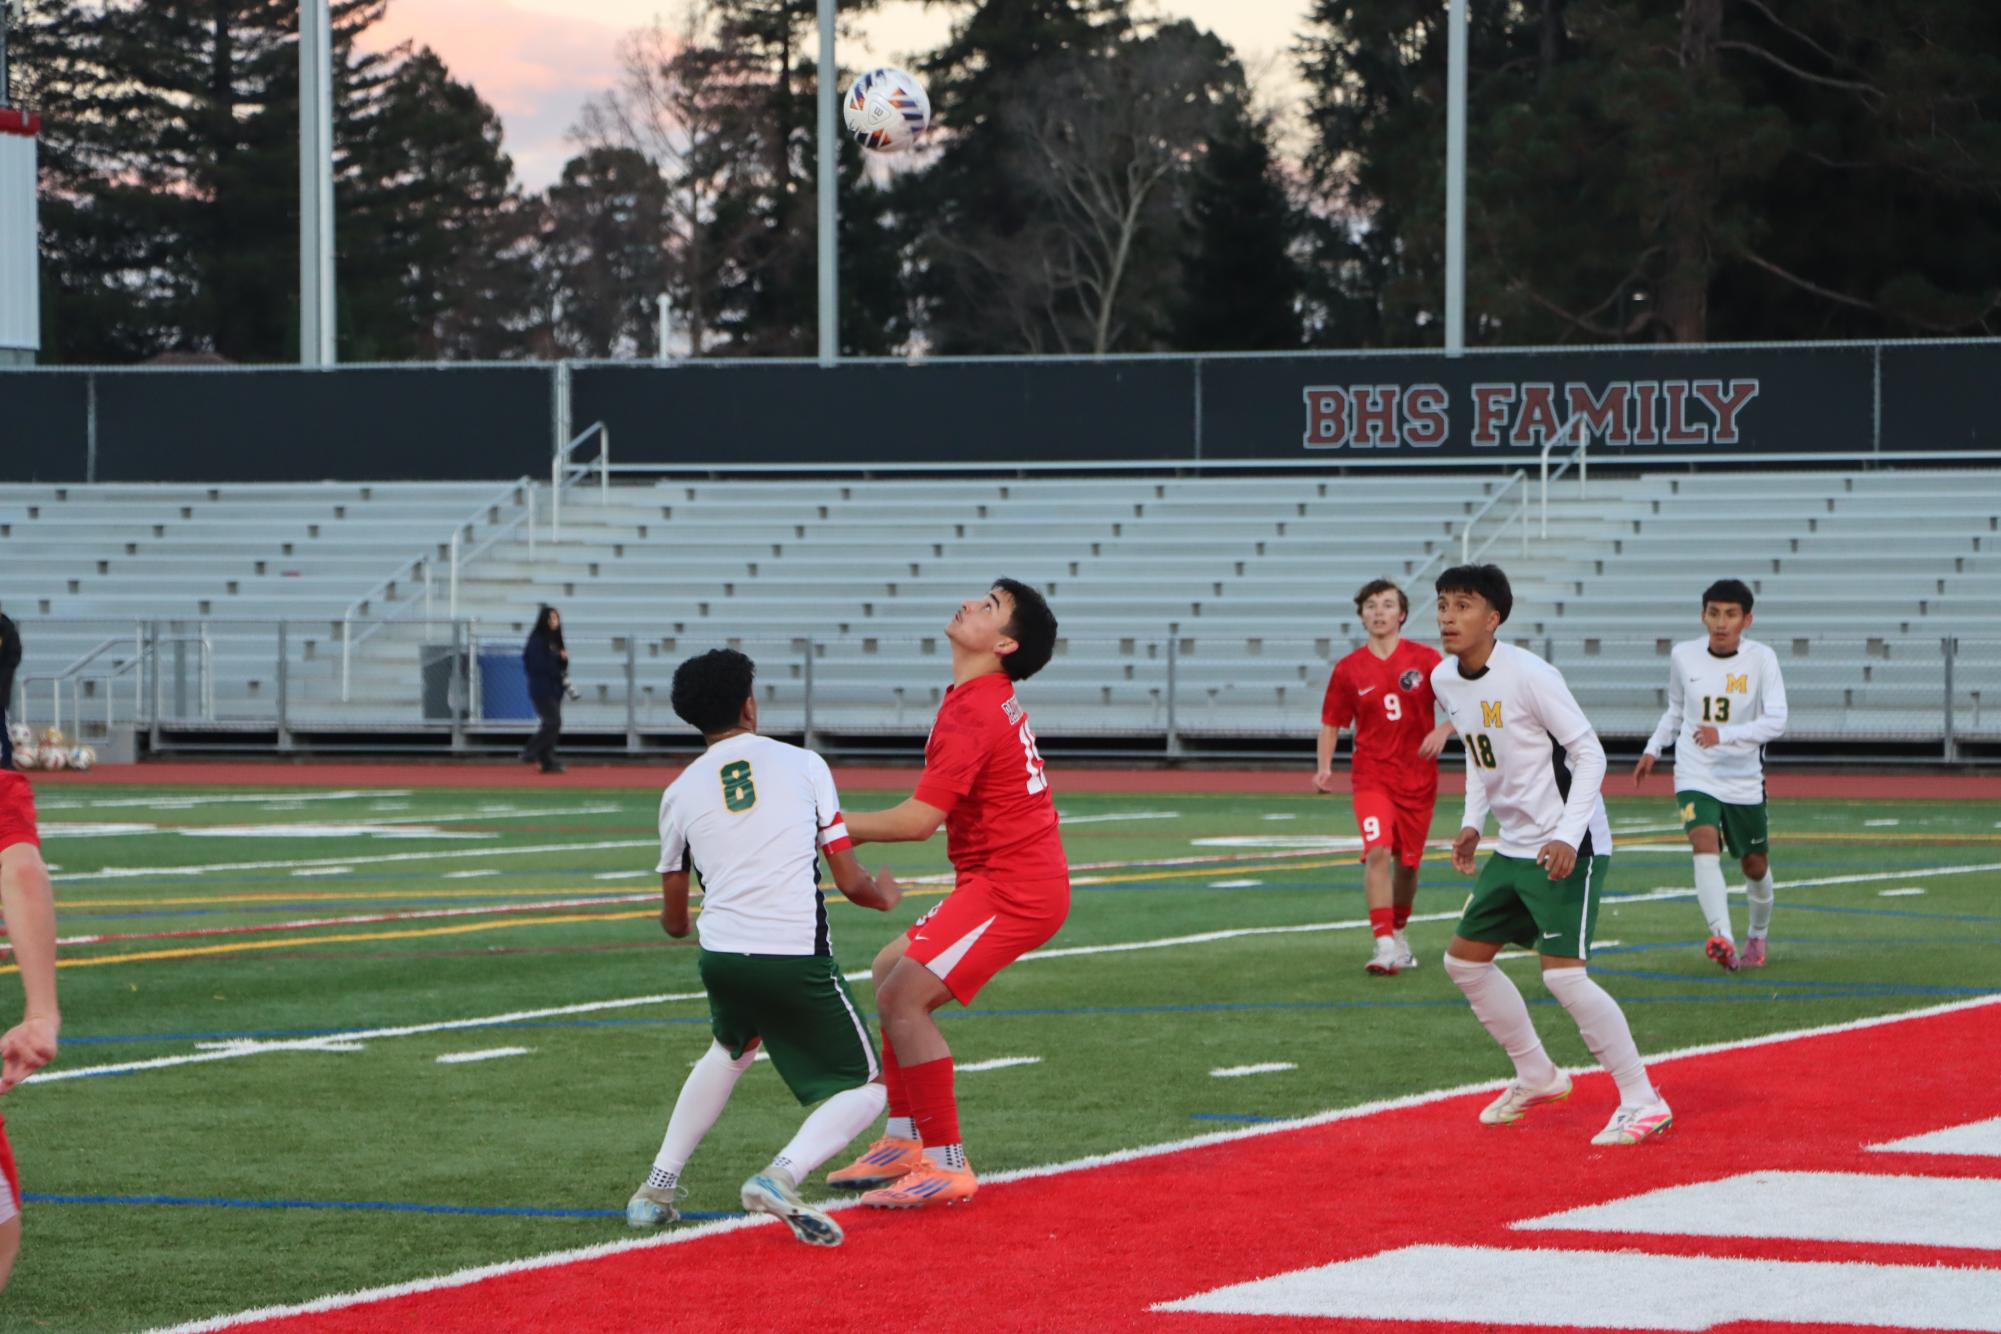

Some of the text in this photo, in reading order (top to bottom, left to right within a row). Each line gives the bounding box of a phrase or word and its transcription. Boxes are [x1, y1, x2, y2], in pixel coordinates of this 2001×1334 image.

[1303, 378, 1760, 449] BHS FAMILY
[1725, 673, 1748, 695] M
[1383, 693, 1402, 721] 9
[1480, 700, 1503, 728] M
[1702, 695, 1731, 723] 13
[1465, 733, 1496, 769] 18
[719, 758, 758, 815] 8
[1363, 815, 1381, 842] 9
